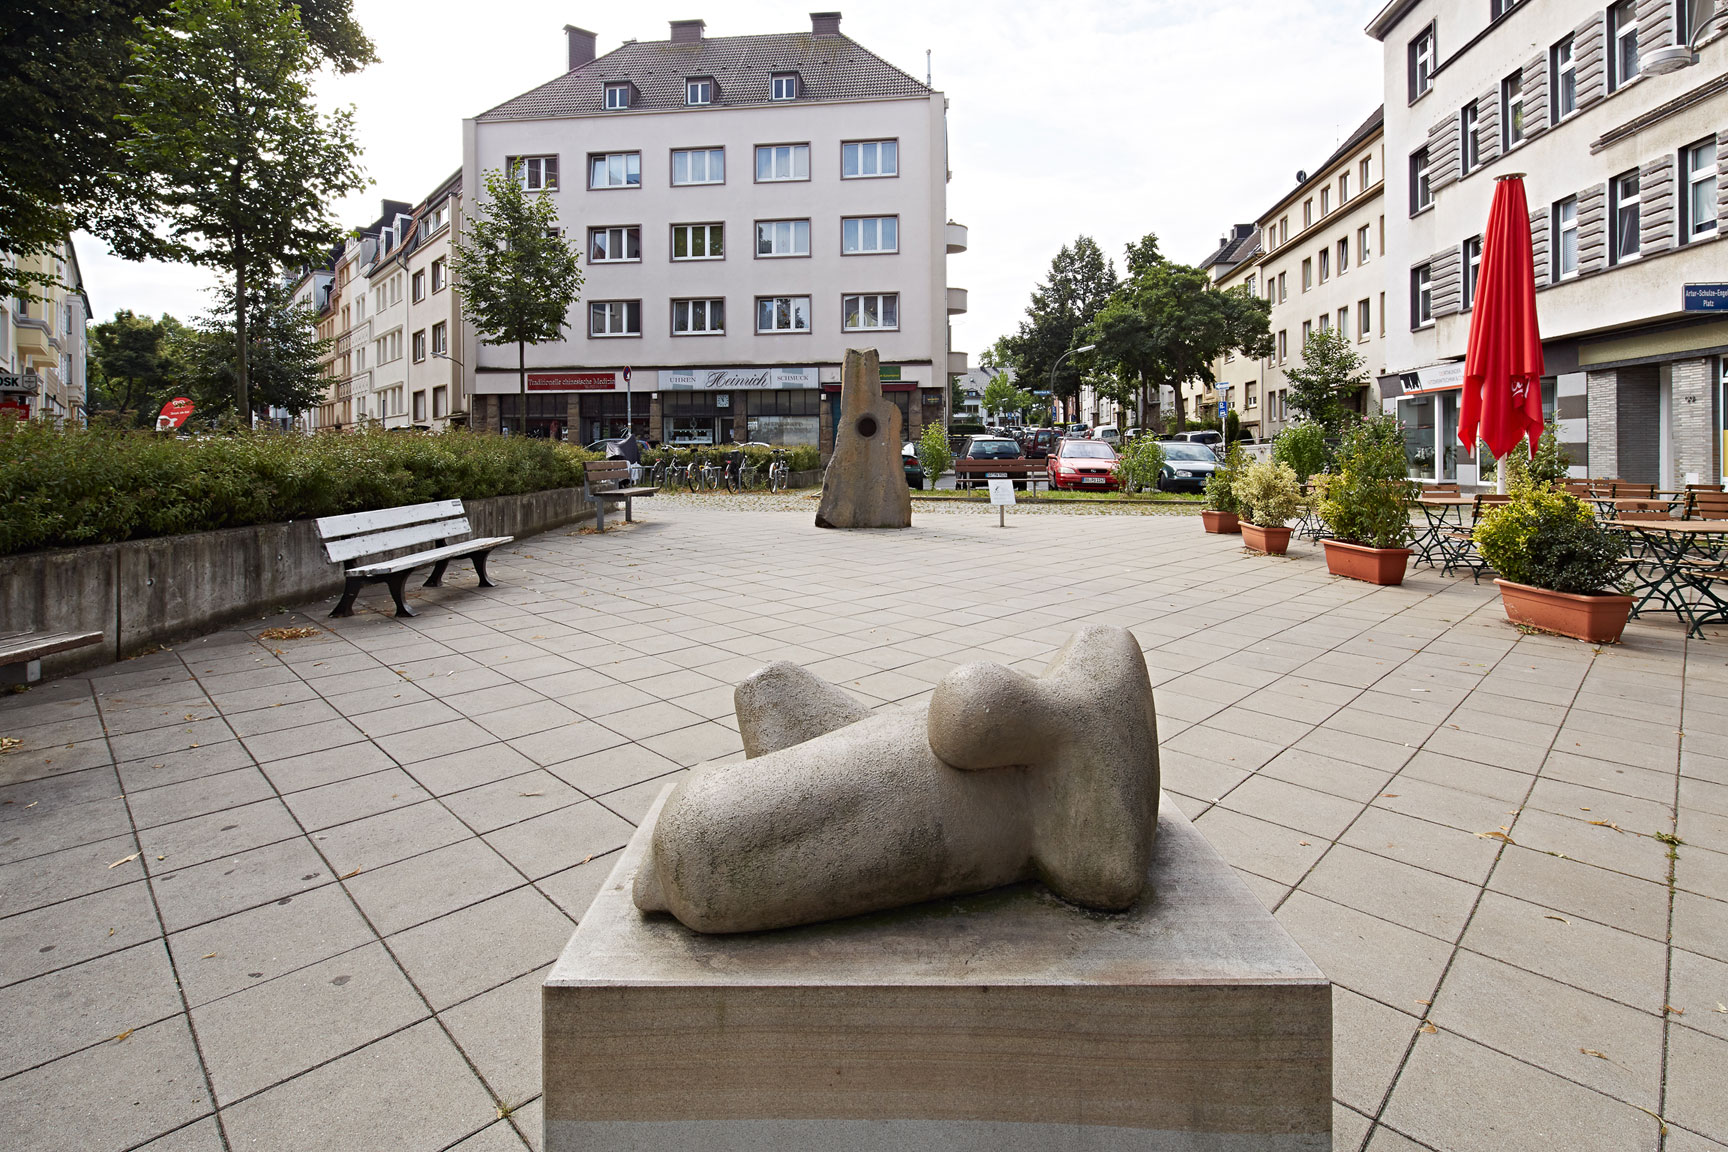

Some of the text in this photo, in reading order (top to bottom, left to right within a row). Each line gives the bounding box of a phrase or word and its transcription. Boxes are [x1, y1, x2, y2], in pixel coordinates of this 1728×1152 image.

[1703, 299, 1715, 307] Platz
[592, 377, 615, 385] Medizin
[706, 371, 768, 388] Heinrich
